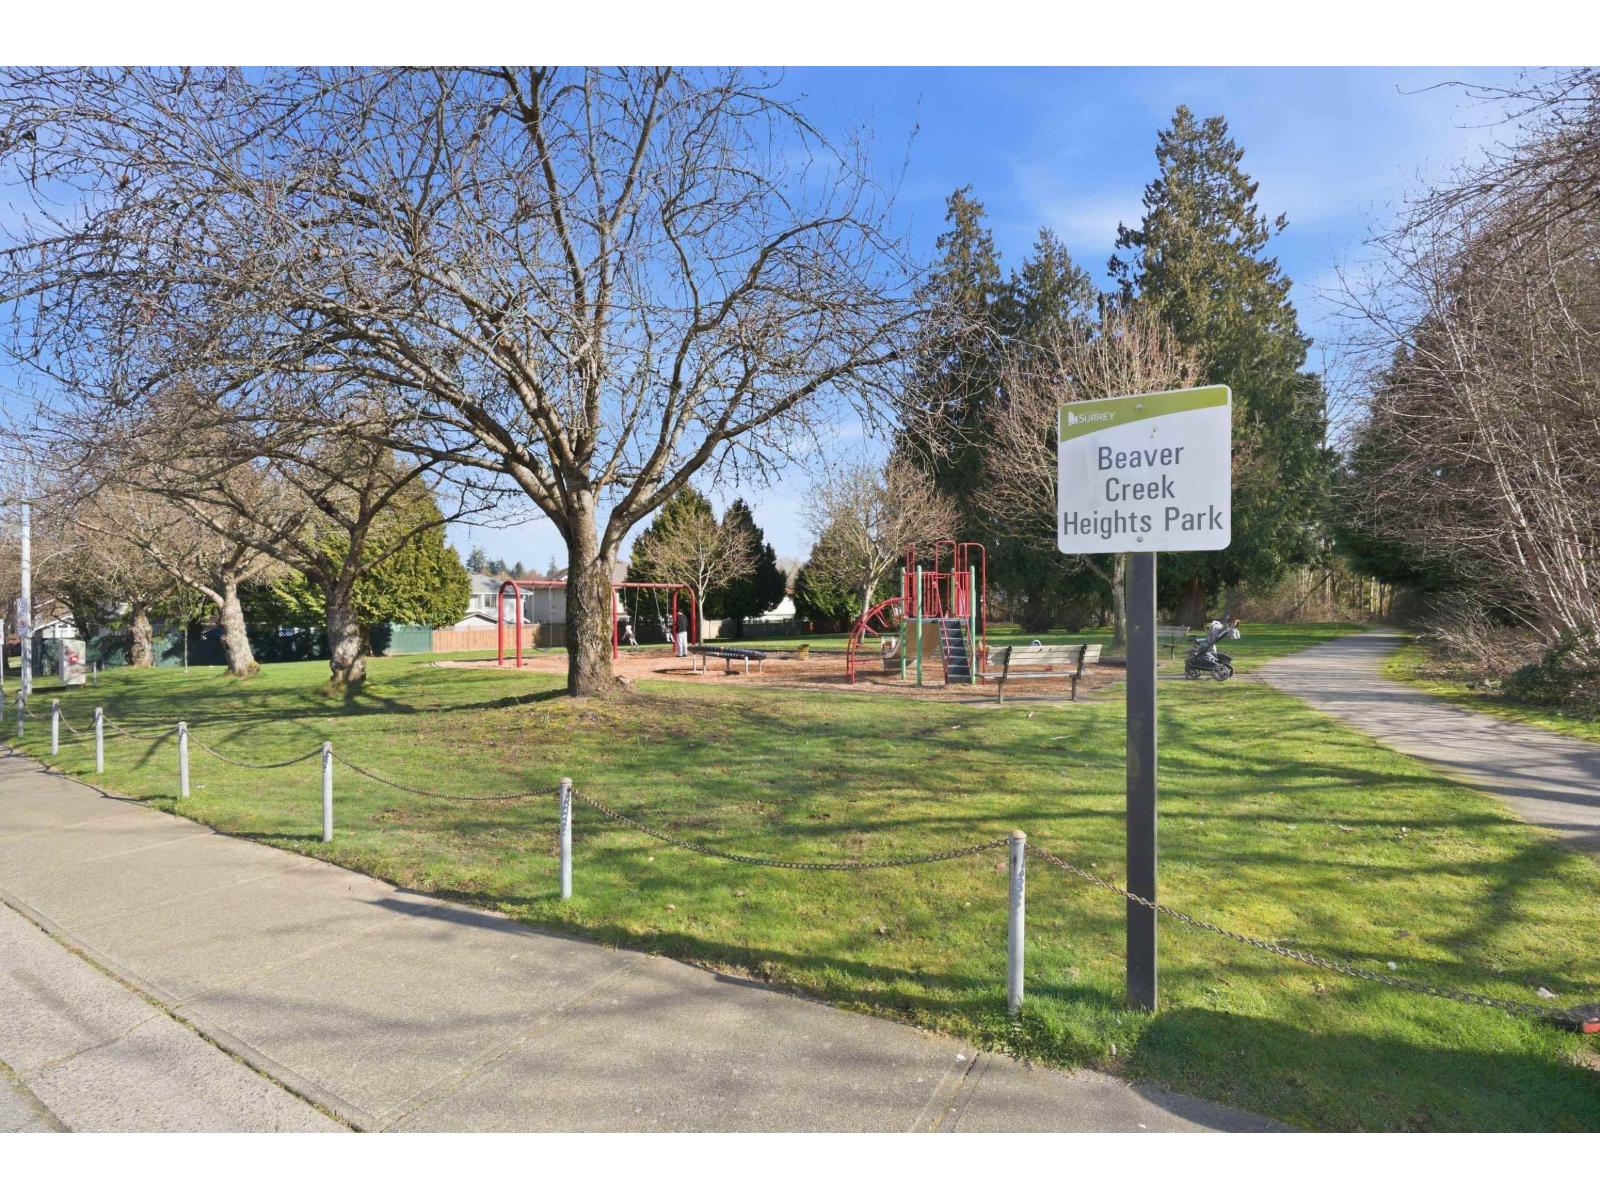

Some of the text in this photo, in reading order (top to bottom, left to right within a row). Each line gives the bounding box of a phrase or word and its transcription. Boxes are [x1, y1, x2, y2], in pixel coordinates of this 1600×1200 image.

[1079, 412, 1115, 423] SURREY
[1098, 446, 1184, 470] Beaver
[1105, 474, 1176, 502] Creek
[1064, 505, 1223, 540] Heights Park
